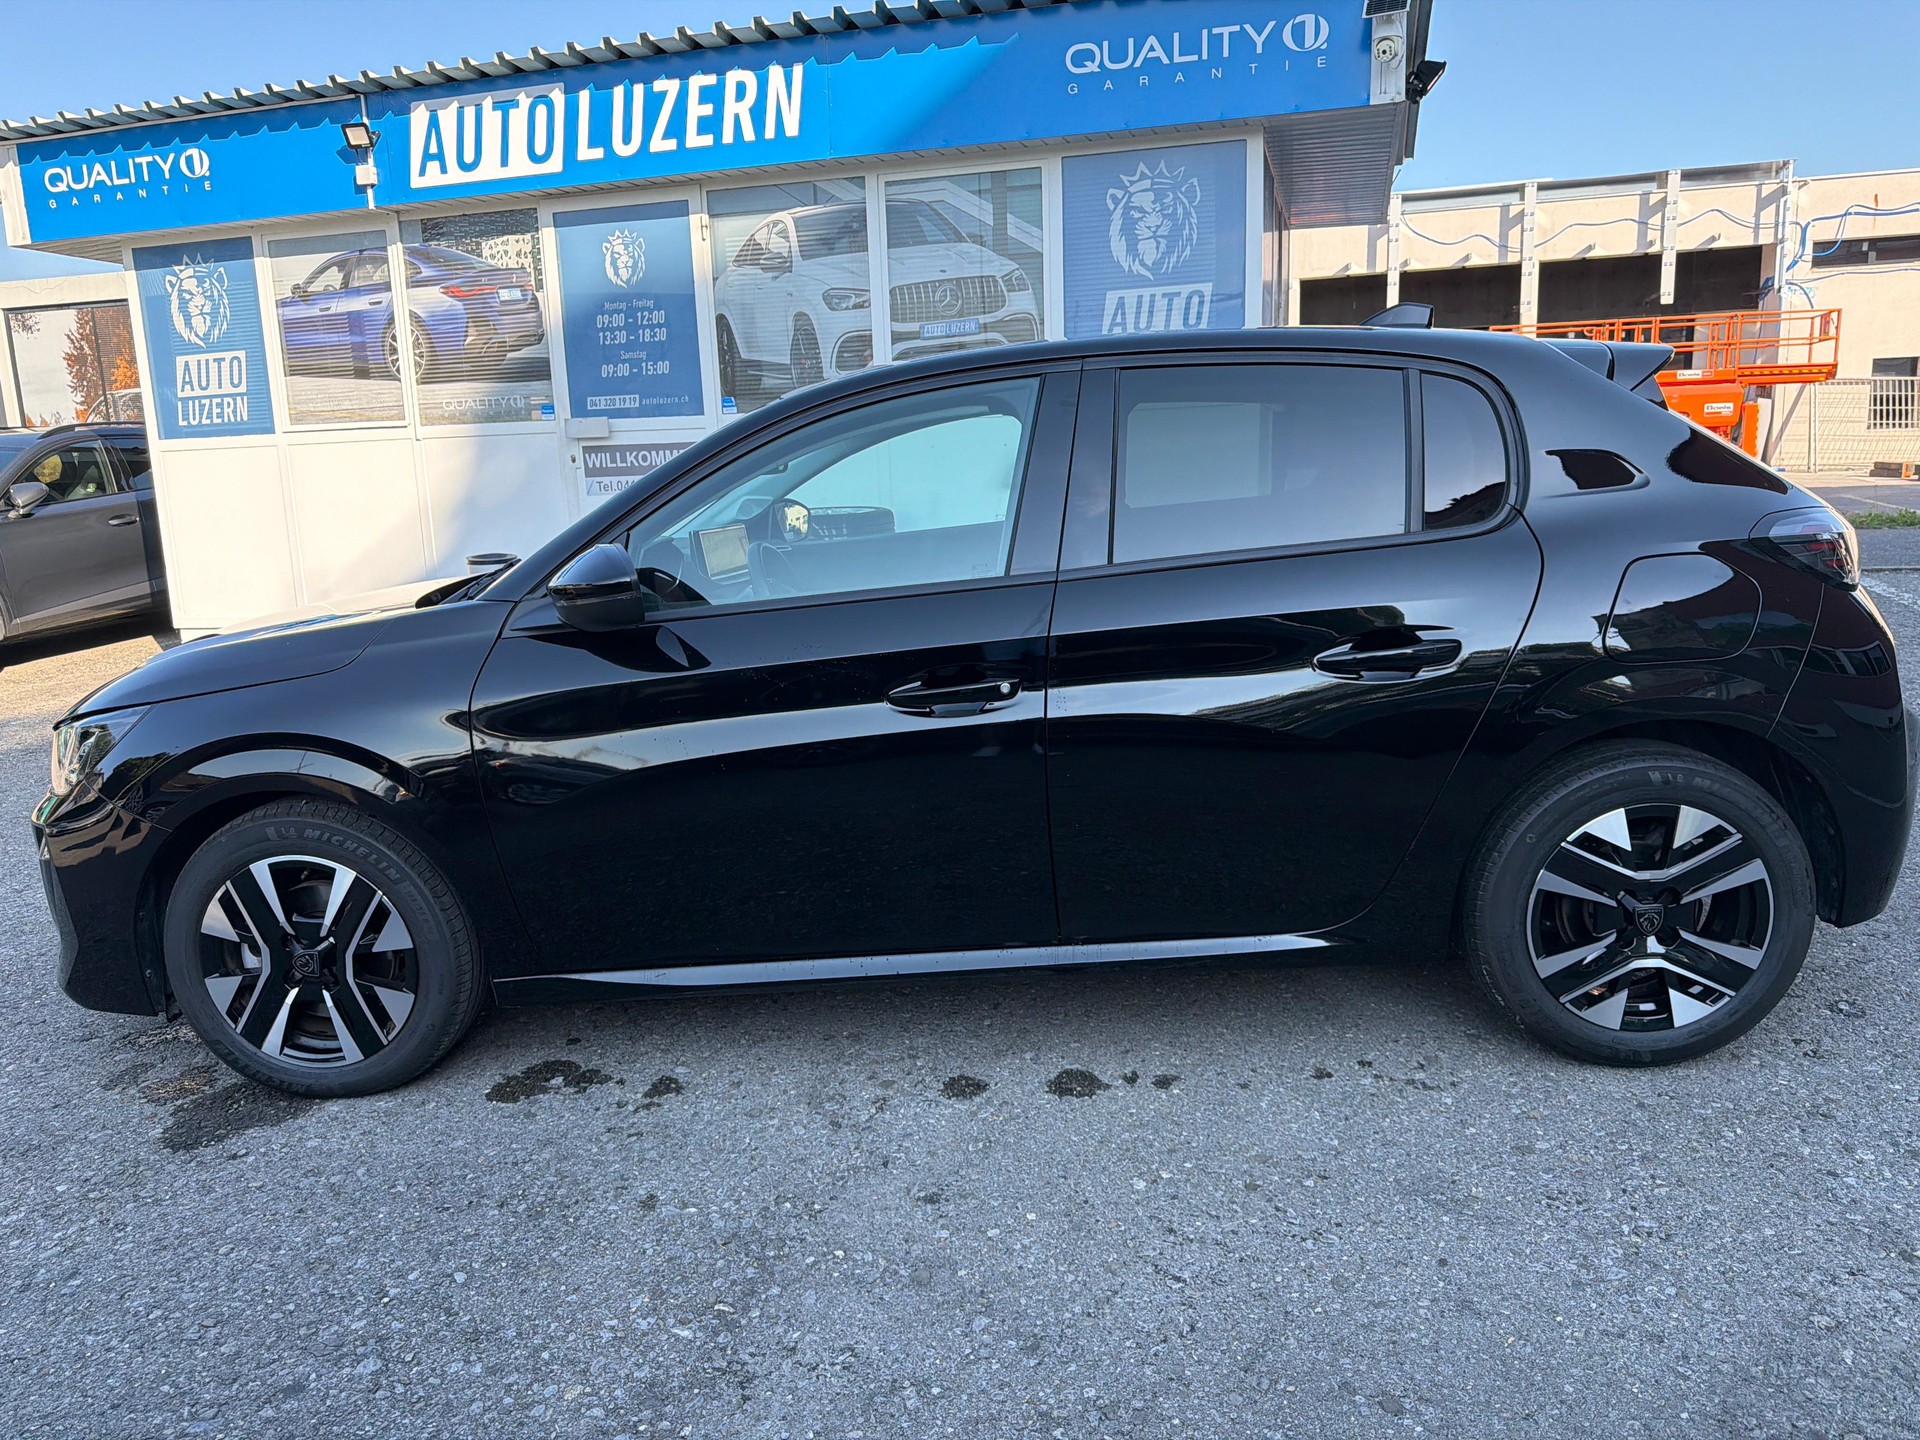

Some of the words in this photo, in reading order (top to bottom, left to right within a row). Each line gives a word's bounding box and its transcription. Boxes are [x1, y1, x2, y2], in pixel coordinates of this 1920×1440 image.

[1065, 20, 1276, 74] QUALITY
[1067, 56, 1326, 94] GARANTIE
[418, 95, 556, 178] AUTO
[577, 63, 803, 161] LUZERN
[44, 153, 175, 193] QUALITY
[49, 181, 213, 209] GARANTIE
[604, 302, 626, 310] Montag
[633, 299, 654, 308] Freitag
[1109, 289, 1206, 334] AUTO
[597, 313, 625, 328] 09:00
[637, 310, 665, 325] 12:00
[599, 330, 627, 345] 13:30
[639, 328, 667, 342] 18:30
[925, 323, 945, 336] AUTO
[946, 321, 976, 334] LUZERN
[620, 351, 647, 361] Samstag
[180, 355, 243, 393] AUTO
[601, 363, 630, 378] 09:00
[641, 361, 670, 375] 15:00
[443, 397, 508, 410] QUALITY
[589, 398, 601, 408] 041
[603, 397, 617, 407] 320
[618, 397, 627, 406] 19
[628, 396, 637, 406] 19
[642, 395, 689, 405] autoluzern.ch
[177, 397, 249, 426] LUZERN
[585, 450, 686, 468] WILLKOMM
[303, 828, 401, 882] MICHELIN
